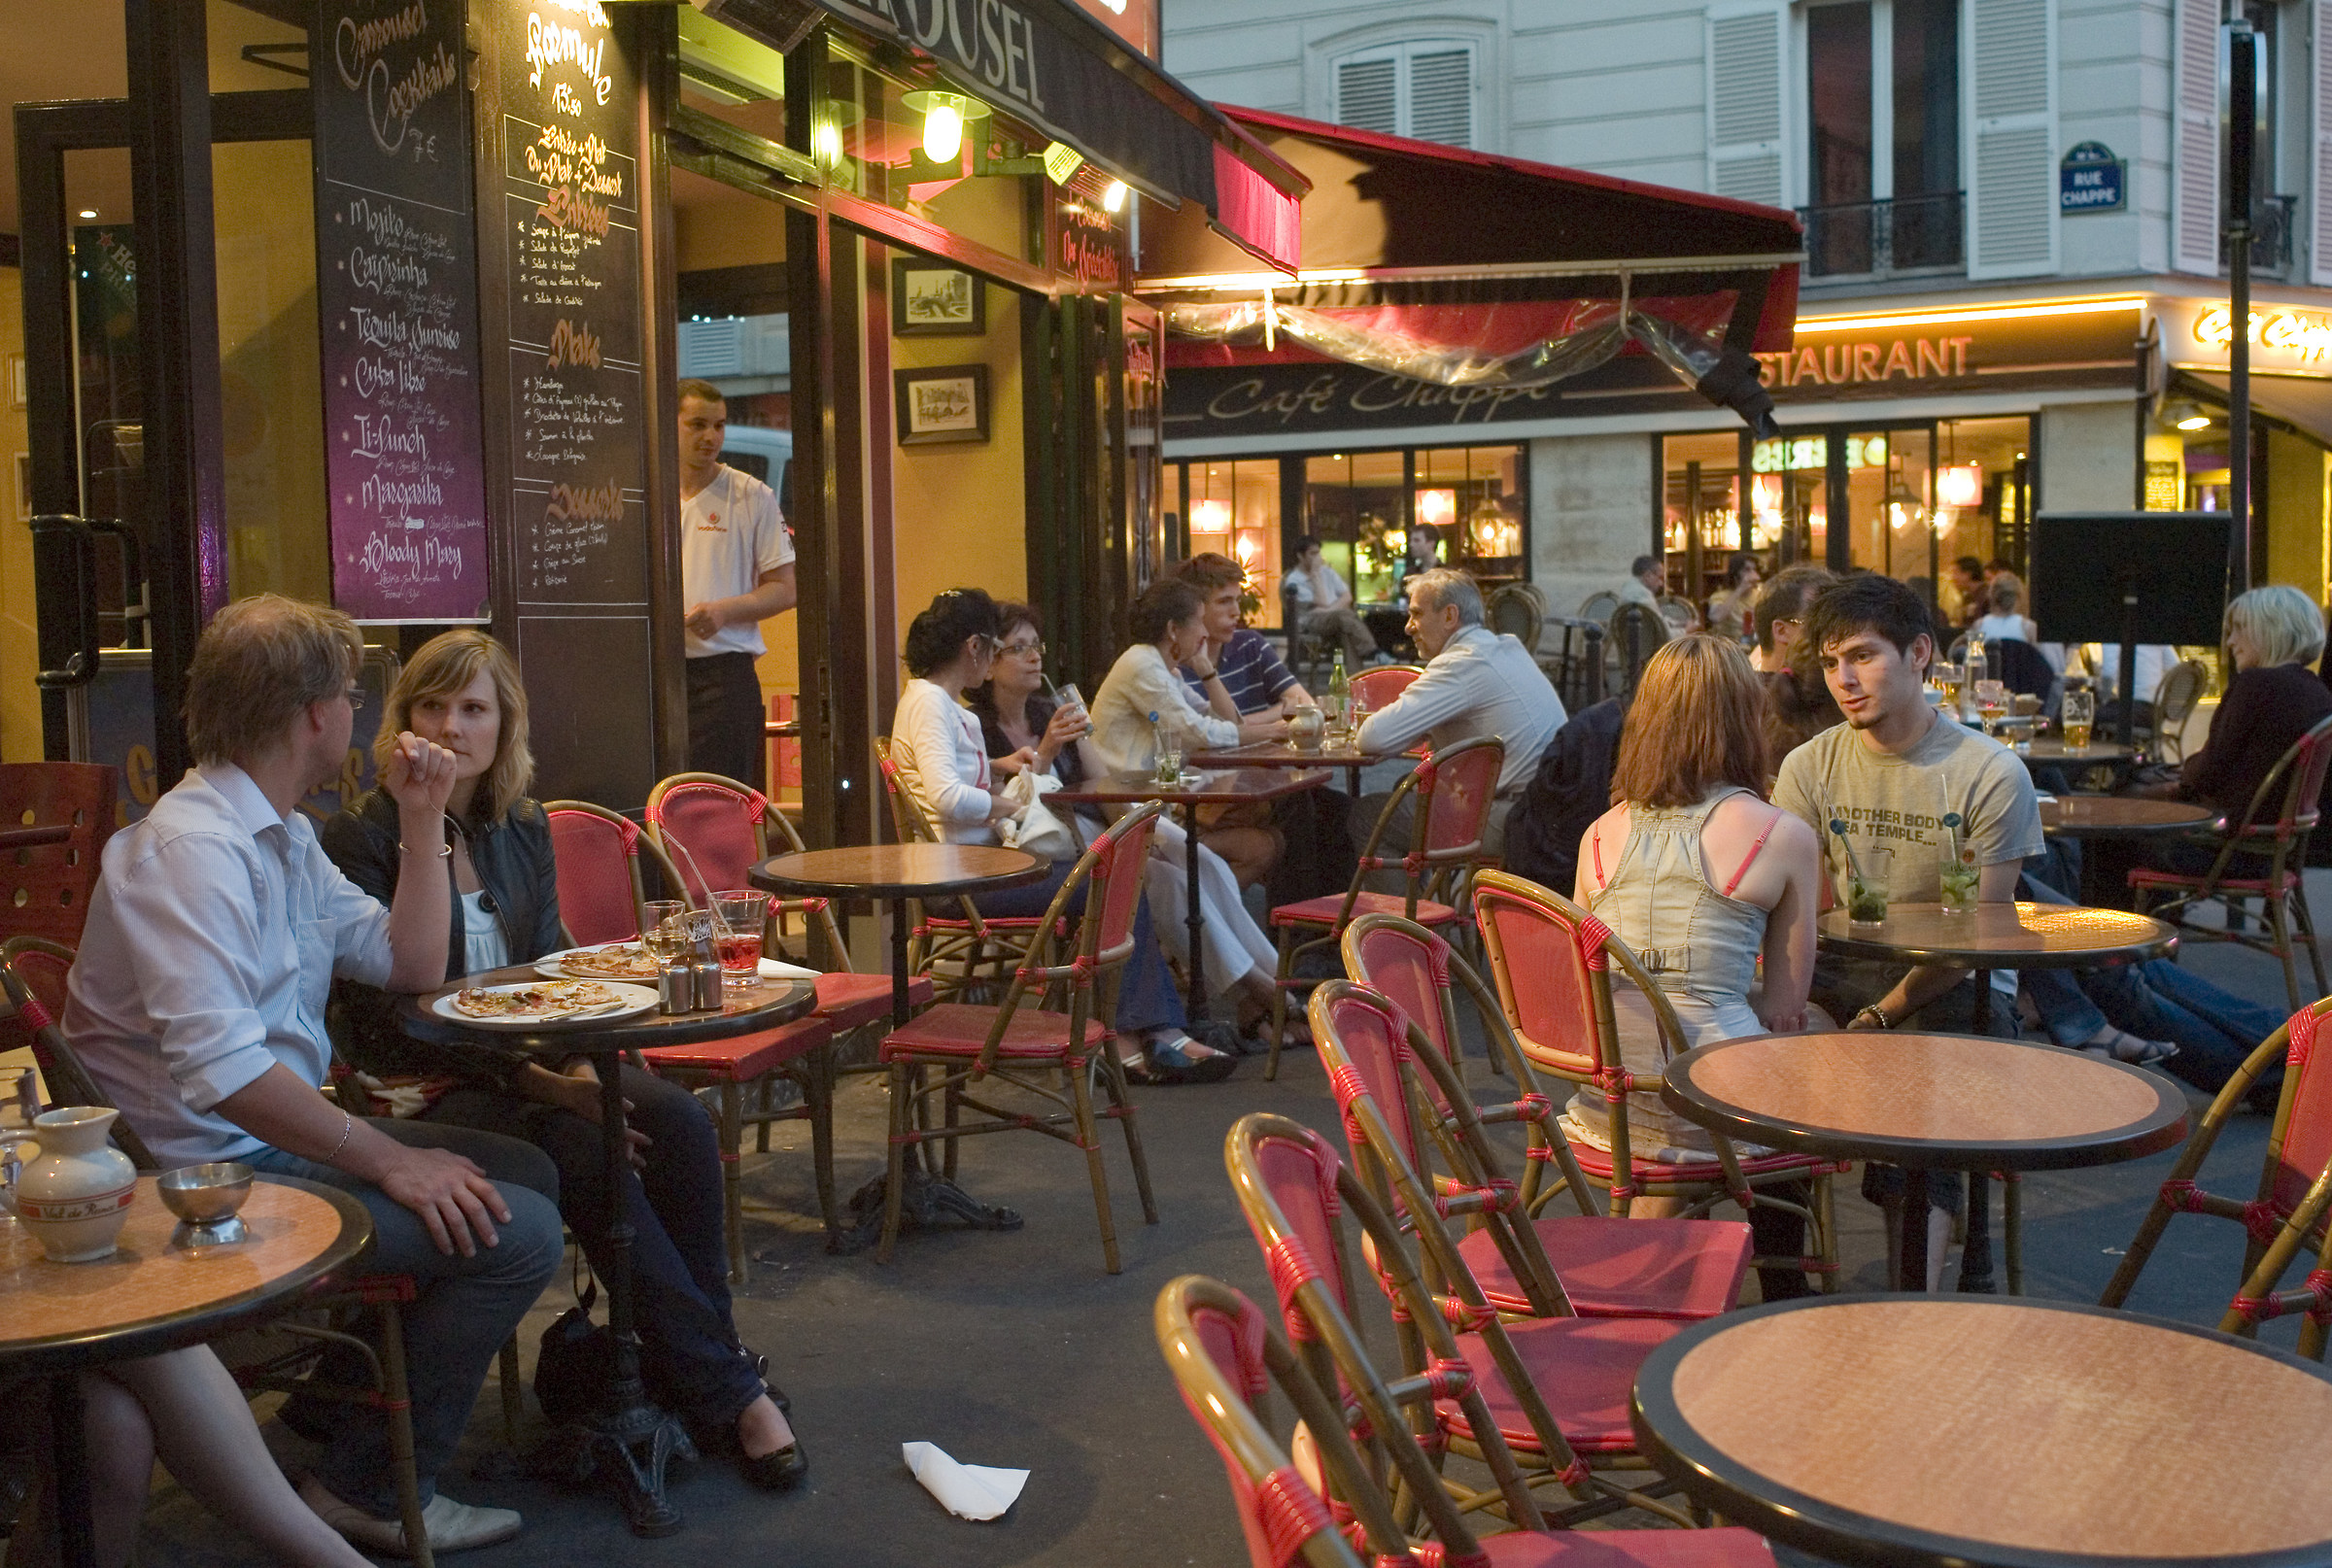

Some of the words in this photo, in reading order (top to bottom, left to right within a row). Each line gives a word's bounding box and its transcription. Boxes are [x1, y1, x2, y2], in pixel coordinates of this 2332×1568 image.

[538, 152, 573, 186] Plat
[578, 132, 606, 169] Plat
[2062, 187, 2116, 205] CHAPPE
[2074, 171, 2104, 187] RUE
[351, 198, 403, 246] Mojito
[1208, 374, 1339, 424] Café
[362, 473, 445, 521] Margarita
[360, 530, 421, 577] Bloody
[426, 536, 463, 580] Mary
[1903, 813, 1943, 831] BODY
